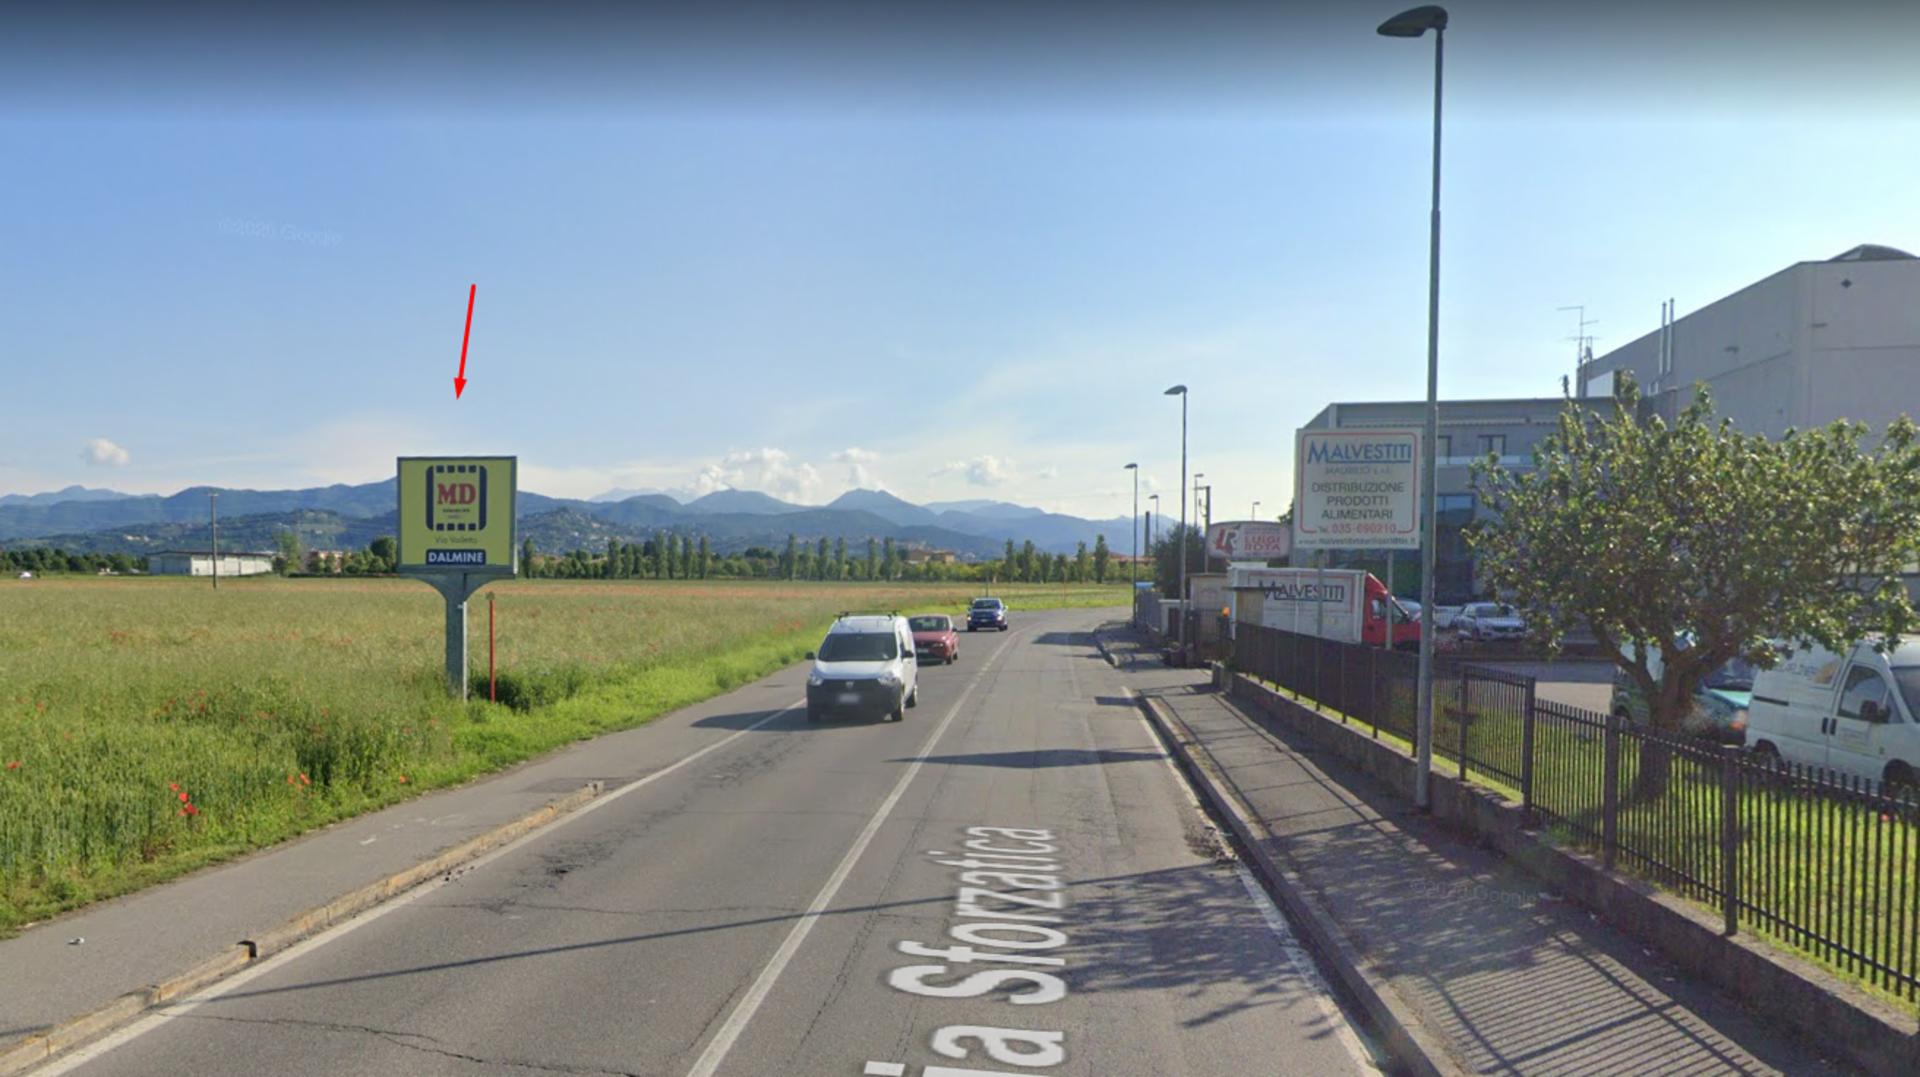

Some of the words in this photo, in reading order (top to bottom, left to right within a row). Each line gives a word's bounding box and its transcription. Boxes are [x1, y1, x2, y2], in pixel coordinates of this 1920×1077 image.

[1308, 441, 1411, 464] MALVESTITI
[1311, 481, 1405, 493] DISTRIBUZIONE
[437, 483, 477, 506] MD
[1327, 495, 1389, 506] PRODOTTI
[1321, 508, 1393, 520] ALIMENTARI
[1244, 535, 1281, 543] LUIGI
[1244, 543, 1281, 551] ROTA
[427, 552, 484, 563] DALMINE
